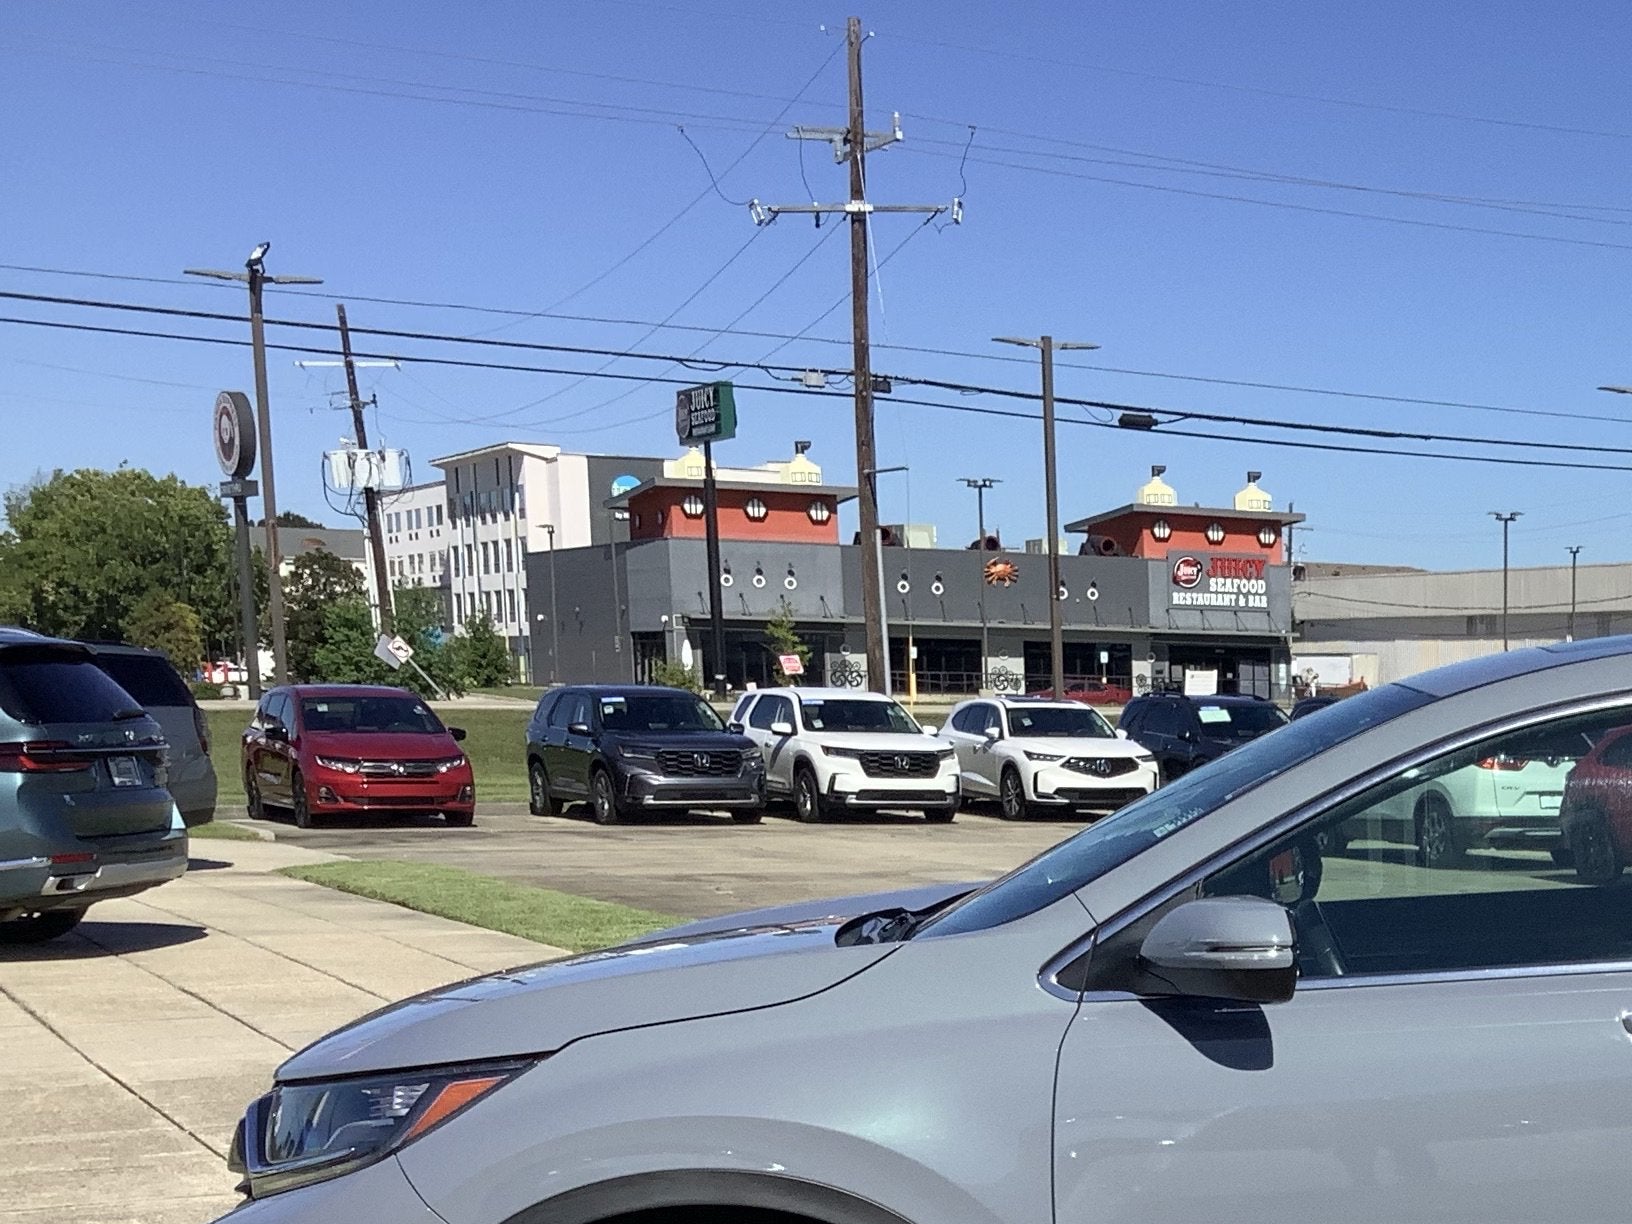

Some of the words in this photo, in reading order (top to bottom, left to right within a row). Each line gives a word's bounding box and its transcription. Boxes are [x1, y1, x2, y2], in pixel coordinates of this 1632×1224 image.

[690, 386, 715, 411] JUICY
[1206, 557, 1266, 579] JUICY
[1209, 577, 1267, 594] SEAFOOD
[1172, 591, 1237, 606] RESTAURANT
[1238, 593, 1246, 607] &
[1247, 595, 1268, 608] BAR
